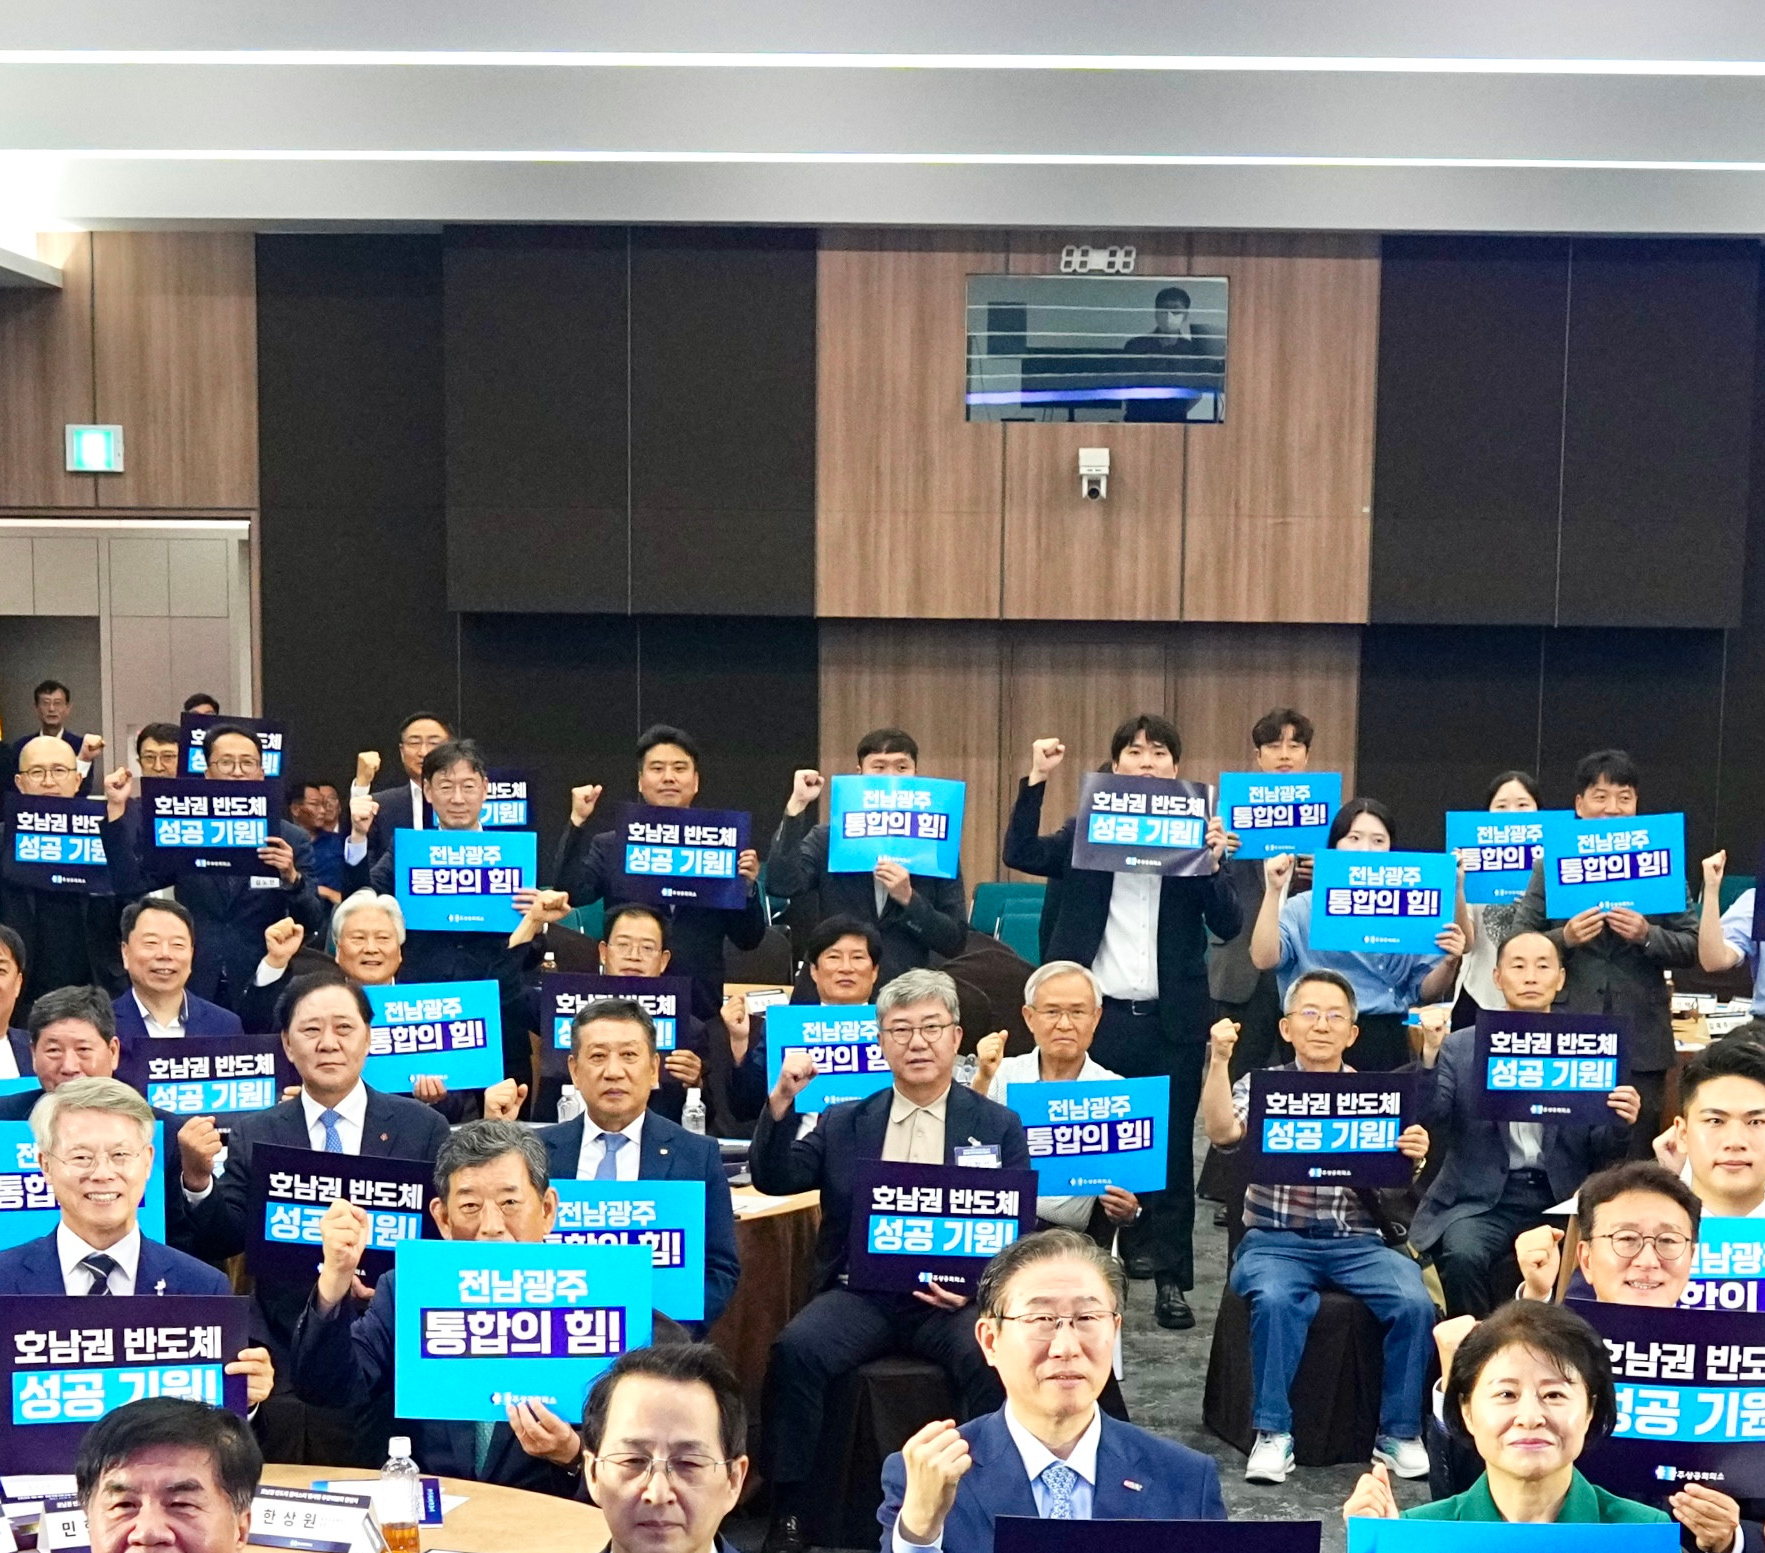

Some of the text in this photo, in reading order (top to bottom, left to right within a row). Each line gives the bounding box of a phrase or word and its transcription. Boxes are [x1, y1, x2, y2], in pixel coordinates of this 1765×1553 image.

[155, 796, 266, 816] 호남권 반도체
[864, 790, 930, 809] 전남광주
[1092, 792, 1205, 817] 호남권 반도체
[1250, 786, 1310, 803] 전남광주
[846, 812, 946, 838] 통합의 힘!
[1233, 804, 1325, 828] 통합의 힘!
[159, 820, 266, 844] 성공 기원!
[628, 823, 736, 846] 호남권 반도체
[1094, 817, 1199, 845] 성공 기원!
[1578, 830, 1649, 853] 전남광주
[430, 846, 501, 865] 전남광주
[630, 848, 732, 875] 성공 기원!
[1561, 851, 1667, 883] 통합의 힘!
[412, 869, 521, 893] 통합의 힘!
[1350, 867, 1420, 886] 전남광주
[1329, 890, 1437, 915] 통합의 힘!
[385, 998, 462, 1022] 전남광주
[368, 1021, 483, 1055] 통합의 힘!
[1491, 1032, 1617, 1055] 호남권 반도체
[1491, 1032, 1617, 1055] 호남권 반도체
[149, 1054, 274, 1079] 호남권 반도체
[1492, 1060, 1612, 1088] 성공 기원!
[1492, 1060, 1612, 1088] 성공 기원!
[152, 1081, 271, 1112] 성공 기원!
[1048, 1095, 1130, 1121] 전남광주
[1266, 1092, 1400, 1115] 호남권 반도체
[1027, 1120, 1150, 1155] 통합의 힘!
[1268, 1121, 1398, 1150] 성공 기원!
[872, 1186, 1019, 1216] 호남권 반도체
[874, 1219, 933, 1251] 성공
[459, 1270, 587, 1303] 전남광주
[15, 1326, 221, 1363] 호남권 반도체
[426, 1310, 619, 1354] 통합의 힘!
[20, 1373, 104, 1419] 성공
[1666, 1466, 1725, 1481] 주상공회의소
[263, 1508, 317, 1529] 한상원
